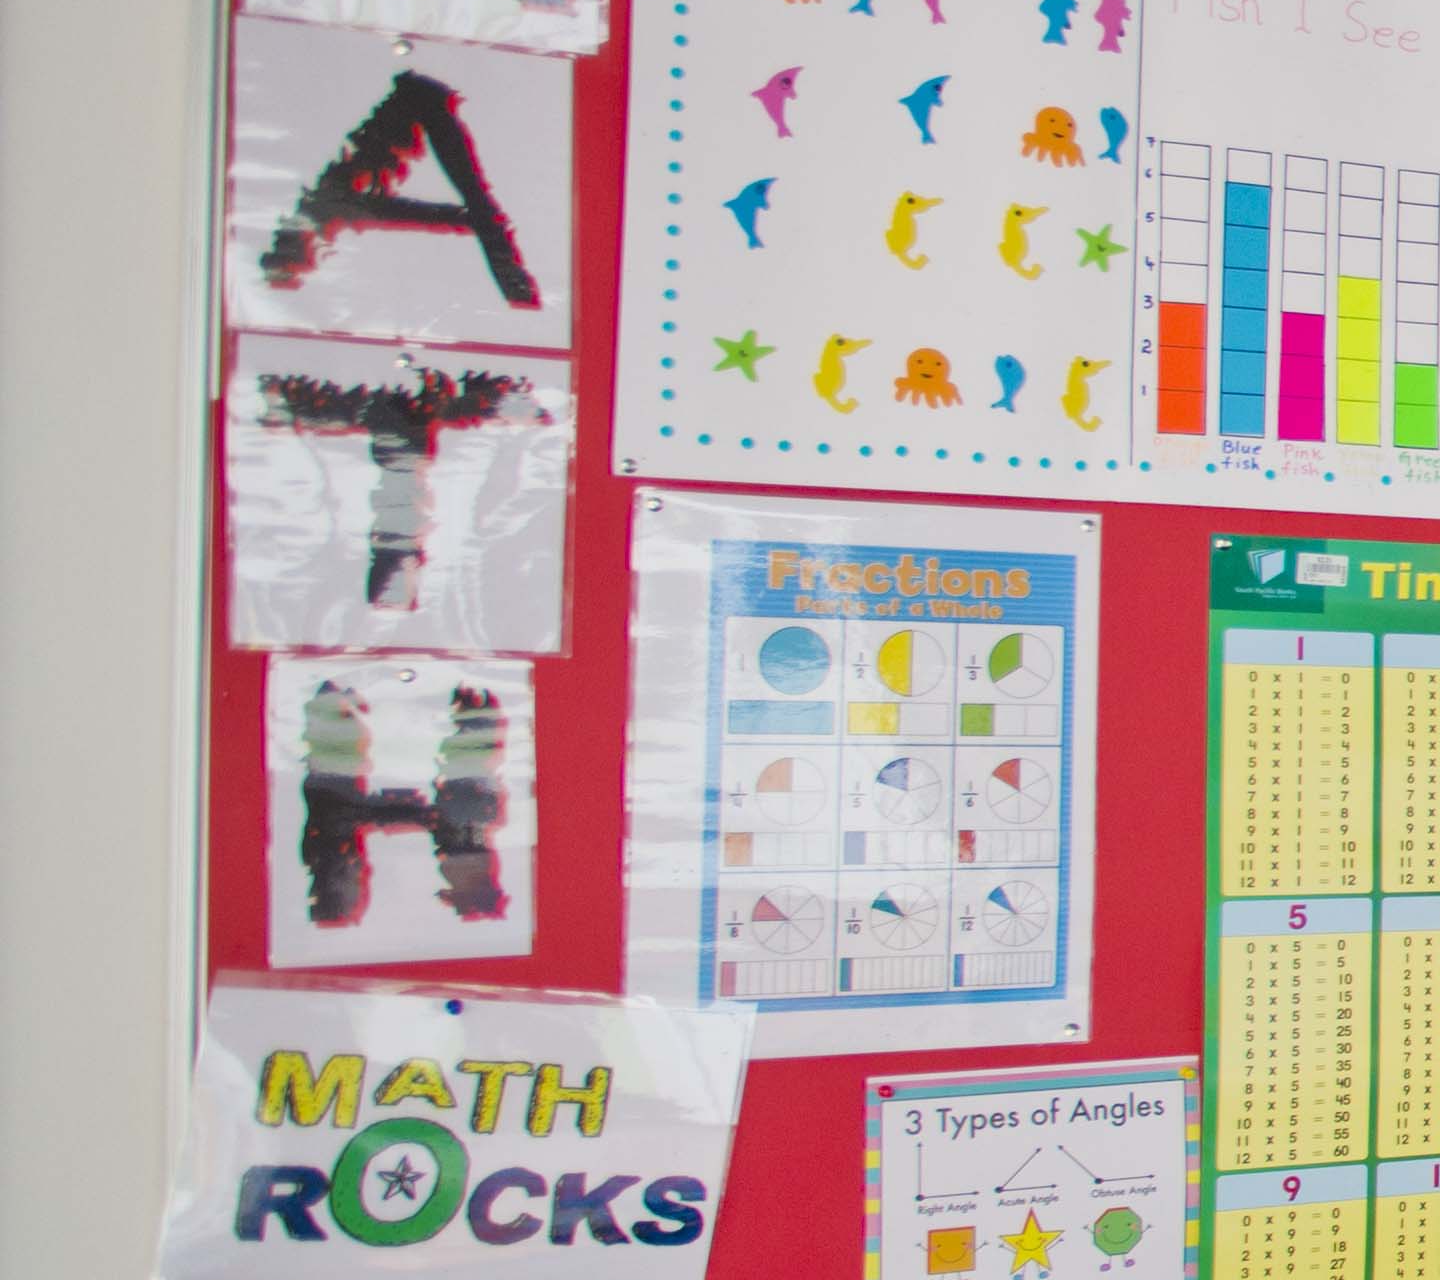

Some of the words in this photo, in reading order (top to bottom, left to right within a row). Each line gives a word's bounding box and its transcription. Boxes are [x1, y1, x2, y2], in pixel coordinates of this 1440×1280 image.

[1342, 0, 1421, 53] See
[767, 551, 1031, 599] Fractions
[256, 1050, 613, 1138] MATH
[905, 1110, 922, 1136] 3
[936, 1107, 1020, 1140] Types
[1031, 1097, 1060, 1126] of
[1069, 1092, 1165, 1127] Angles
[234, 1117, 708, 1248] ROCKS
[1283, 1177, 1301, 1202] 9
